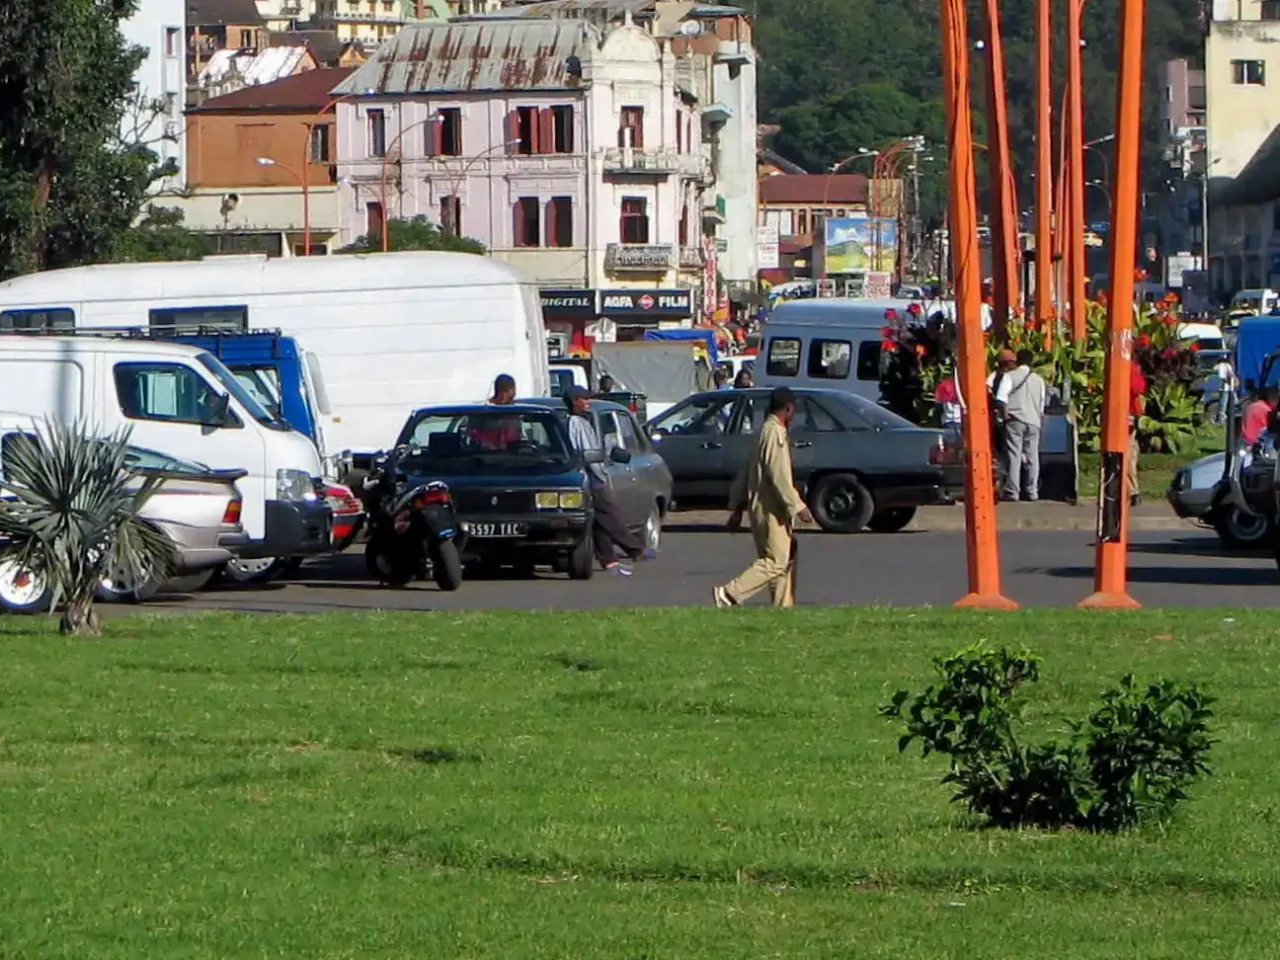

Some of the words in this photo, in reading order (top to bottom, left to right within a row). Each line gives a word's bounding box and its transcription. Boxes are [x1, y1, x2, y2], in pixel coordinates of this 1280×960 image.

[541, 297, 590, 307] DIGITAL
[604, 296, 634, 308] AGFA
[658, 296, 688, 308] FILM
